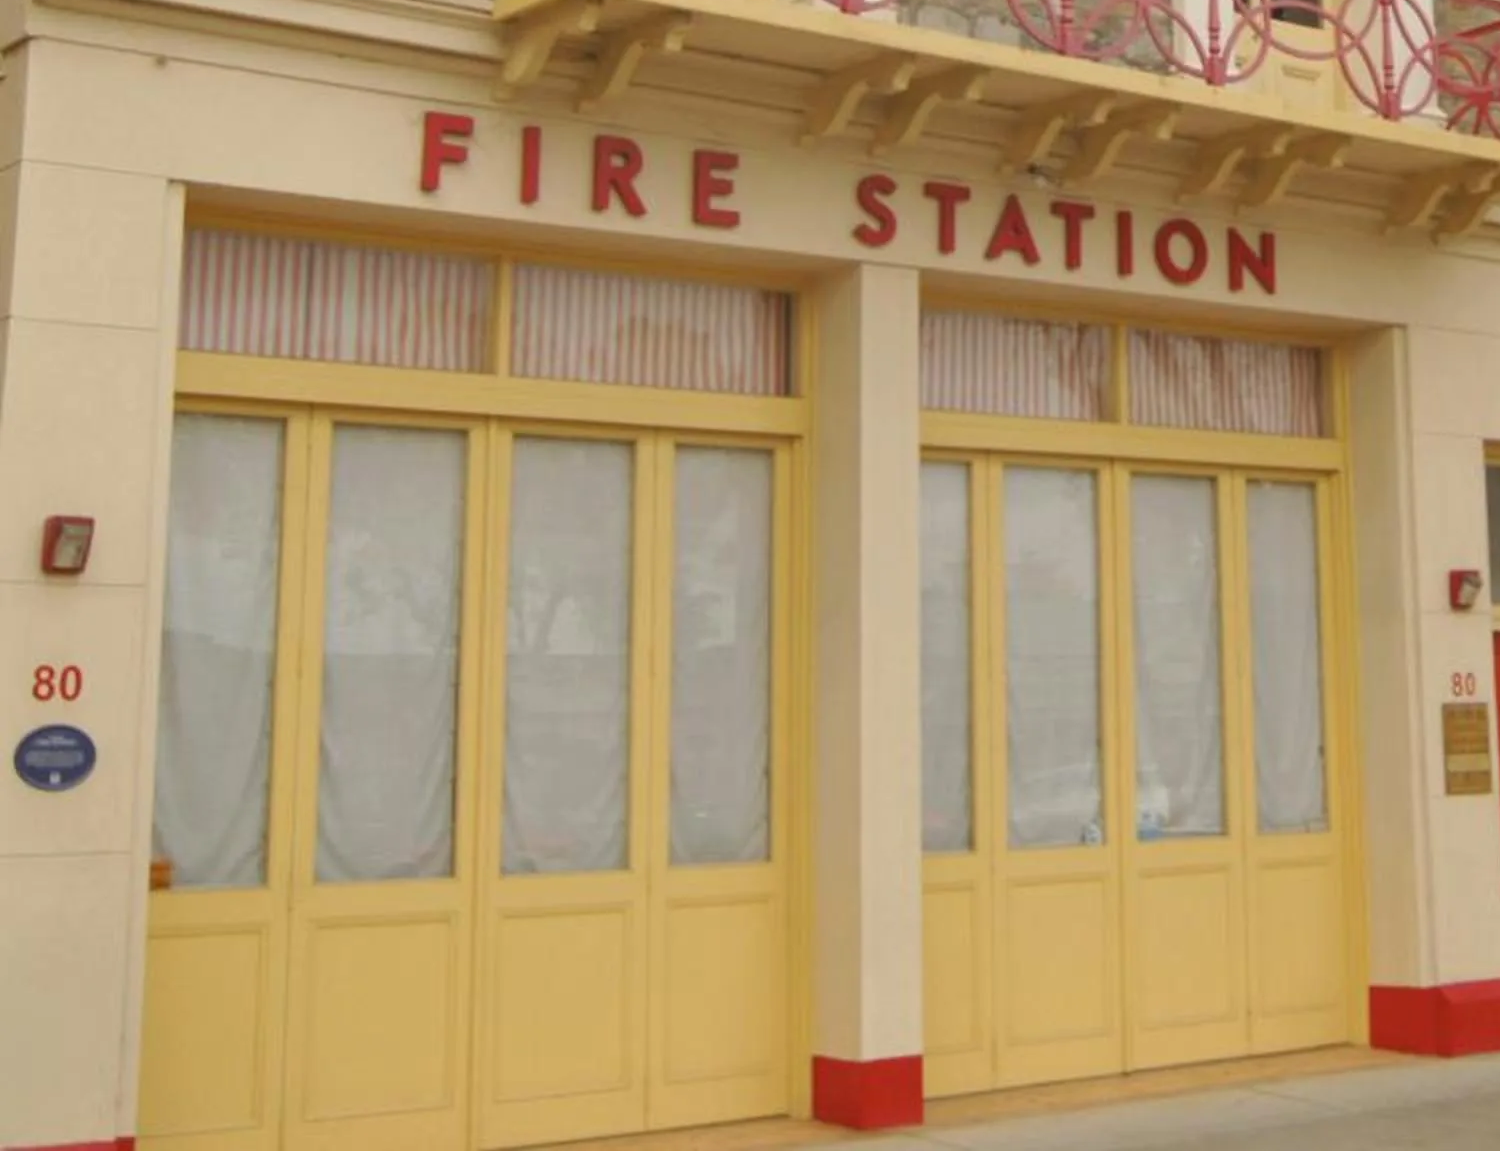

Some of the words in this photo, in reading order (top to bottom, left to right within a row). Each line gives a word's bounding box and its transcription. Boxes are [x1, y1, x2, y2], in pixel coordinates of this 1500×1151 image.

[420, 110, 741, 230] FIRE
[852, 173, 1278, 296] STATION
[32, 665, 82, 701] 80
[1452, 672, 1476, 696] 80
